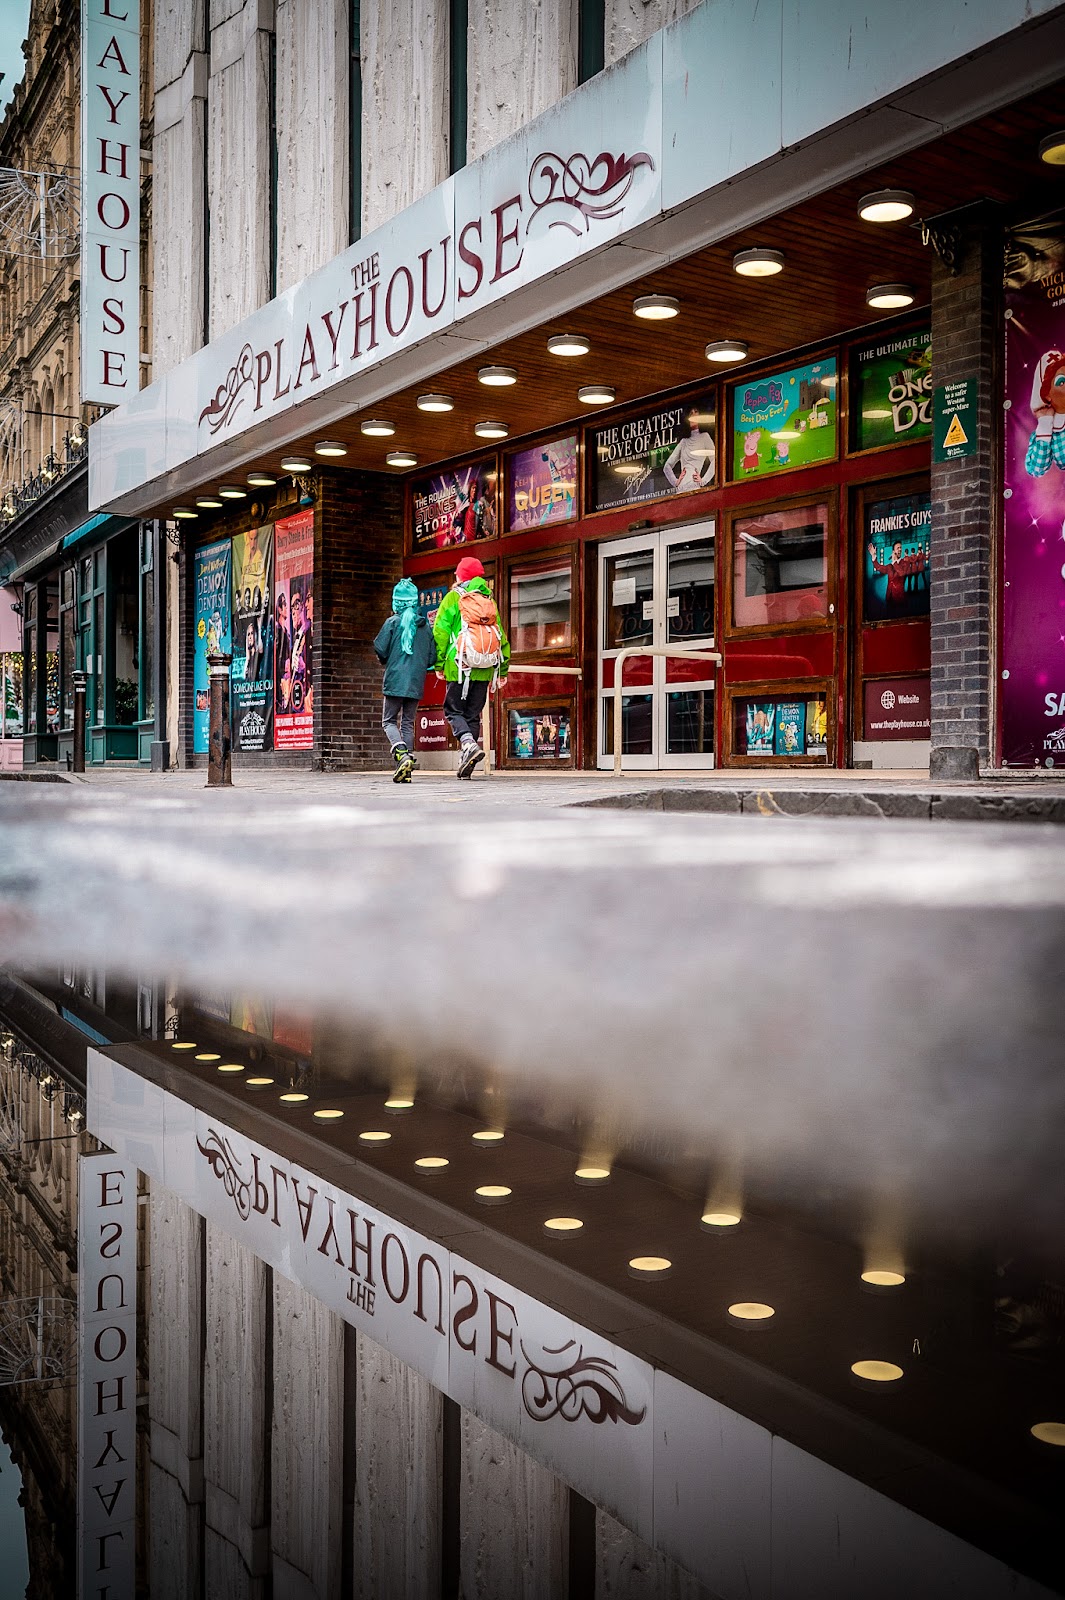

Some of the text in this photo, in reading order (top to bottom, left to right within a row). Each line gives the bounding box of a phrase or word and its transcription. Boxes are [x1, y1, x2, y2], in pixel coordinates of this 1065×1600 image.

[351, 252, 380, 291] THE
[253, 195, 524, 412] PLAYHOUSE
[859, 350, 874, 361] THE
[877, 337, 918, 356] ULTIMATE
[745, 385, 781, 410] Peppa Pig
[945, 382, 968, 392] Welcome
[955, 389, 967, 397] safer
[947, 397, 965, 406] Weston
[596, 408, 683, 446] THE GREATEST
[741, 413, 754, 423] Best
[756, 413, 768, 423] Day
[600, 428, 678, 463] LOVE OF ALL
[415, 484, 456, 509] THE ROLLING
[515, 478, 576, 511] QUEEN
[415, 496, 457, 525] STONES
[415, 511, 456, 538] STORY
[871, 513, 910, 535] FRANKIE'S
[198, 593, 227, 613] DENTIST
[898, 694, 919, 704] Website
